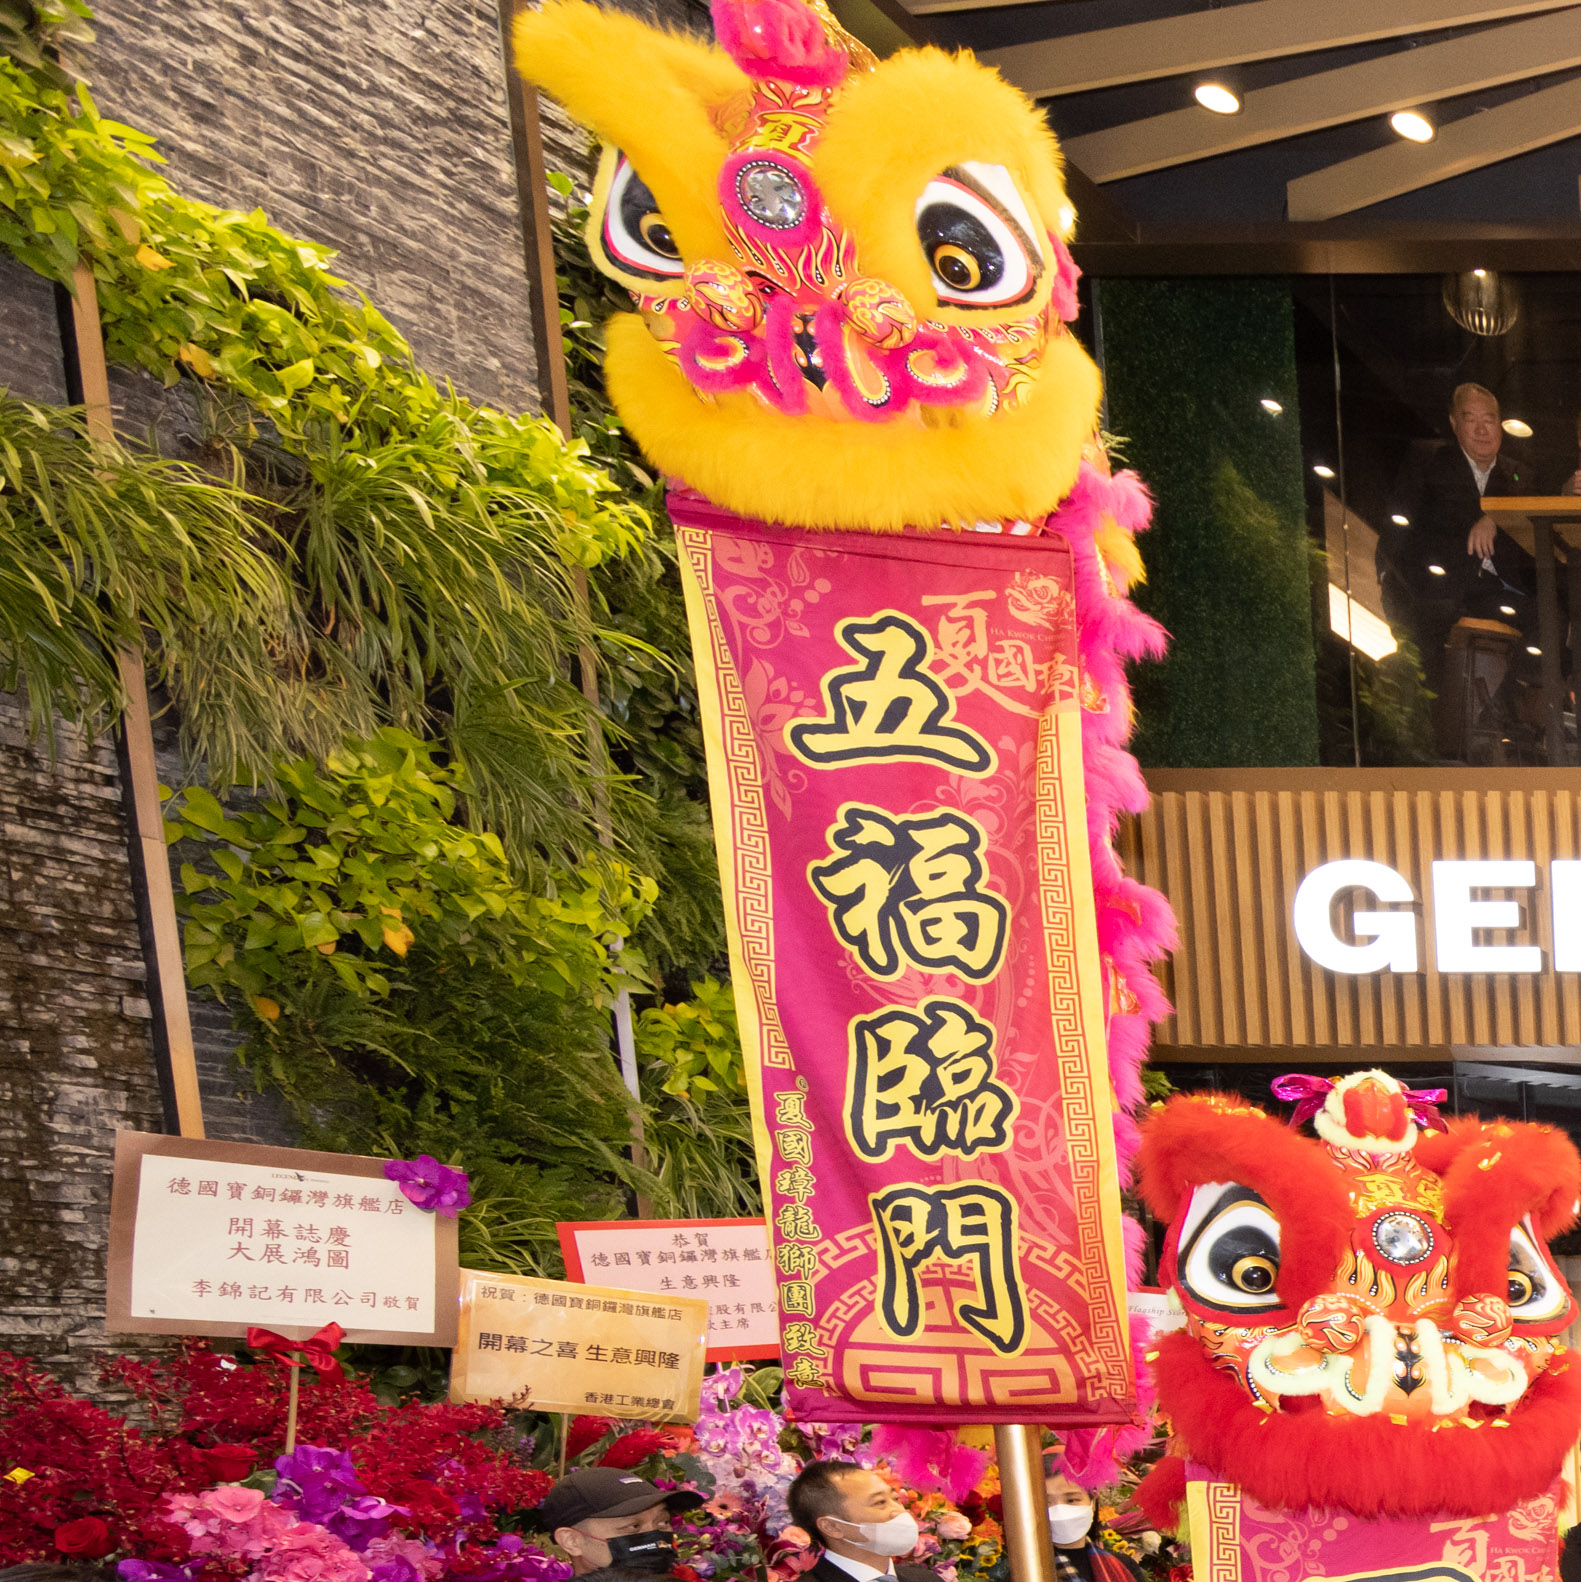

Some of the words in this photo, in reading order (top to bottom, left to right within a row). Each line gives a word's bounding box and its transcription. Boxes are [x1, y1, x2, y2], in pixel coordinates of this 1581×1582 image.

[783, 609, 1034, 1360] 五福臨門
[166, 1176, 405, 1216] 德國寶銅鑼灣旗艦店
[227, 1217, 353, 1248] 開幕誌慶
[671, 1232, 709, 1249] 恭賀
[773, 1090, 828, 1390] 夏國璋龍獅團致意
[225, 1241, 350, 1270] 大展鴻圖
[190, 1278, 378, 1310] 李錦記有限公司
[382, 1294, 421, 1312] 敬賀
[659, 1274, 742, 1291] 生意興隆
[533, 1291, 683, 1322] 德國寶銅鑼灣旗艦店
[478, 1331, 579, 1361] 開幕之喜
[585, 1342, 682, 1372] 生意興隆
[584, 1391, 676, 1411] 香港工業總會
